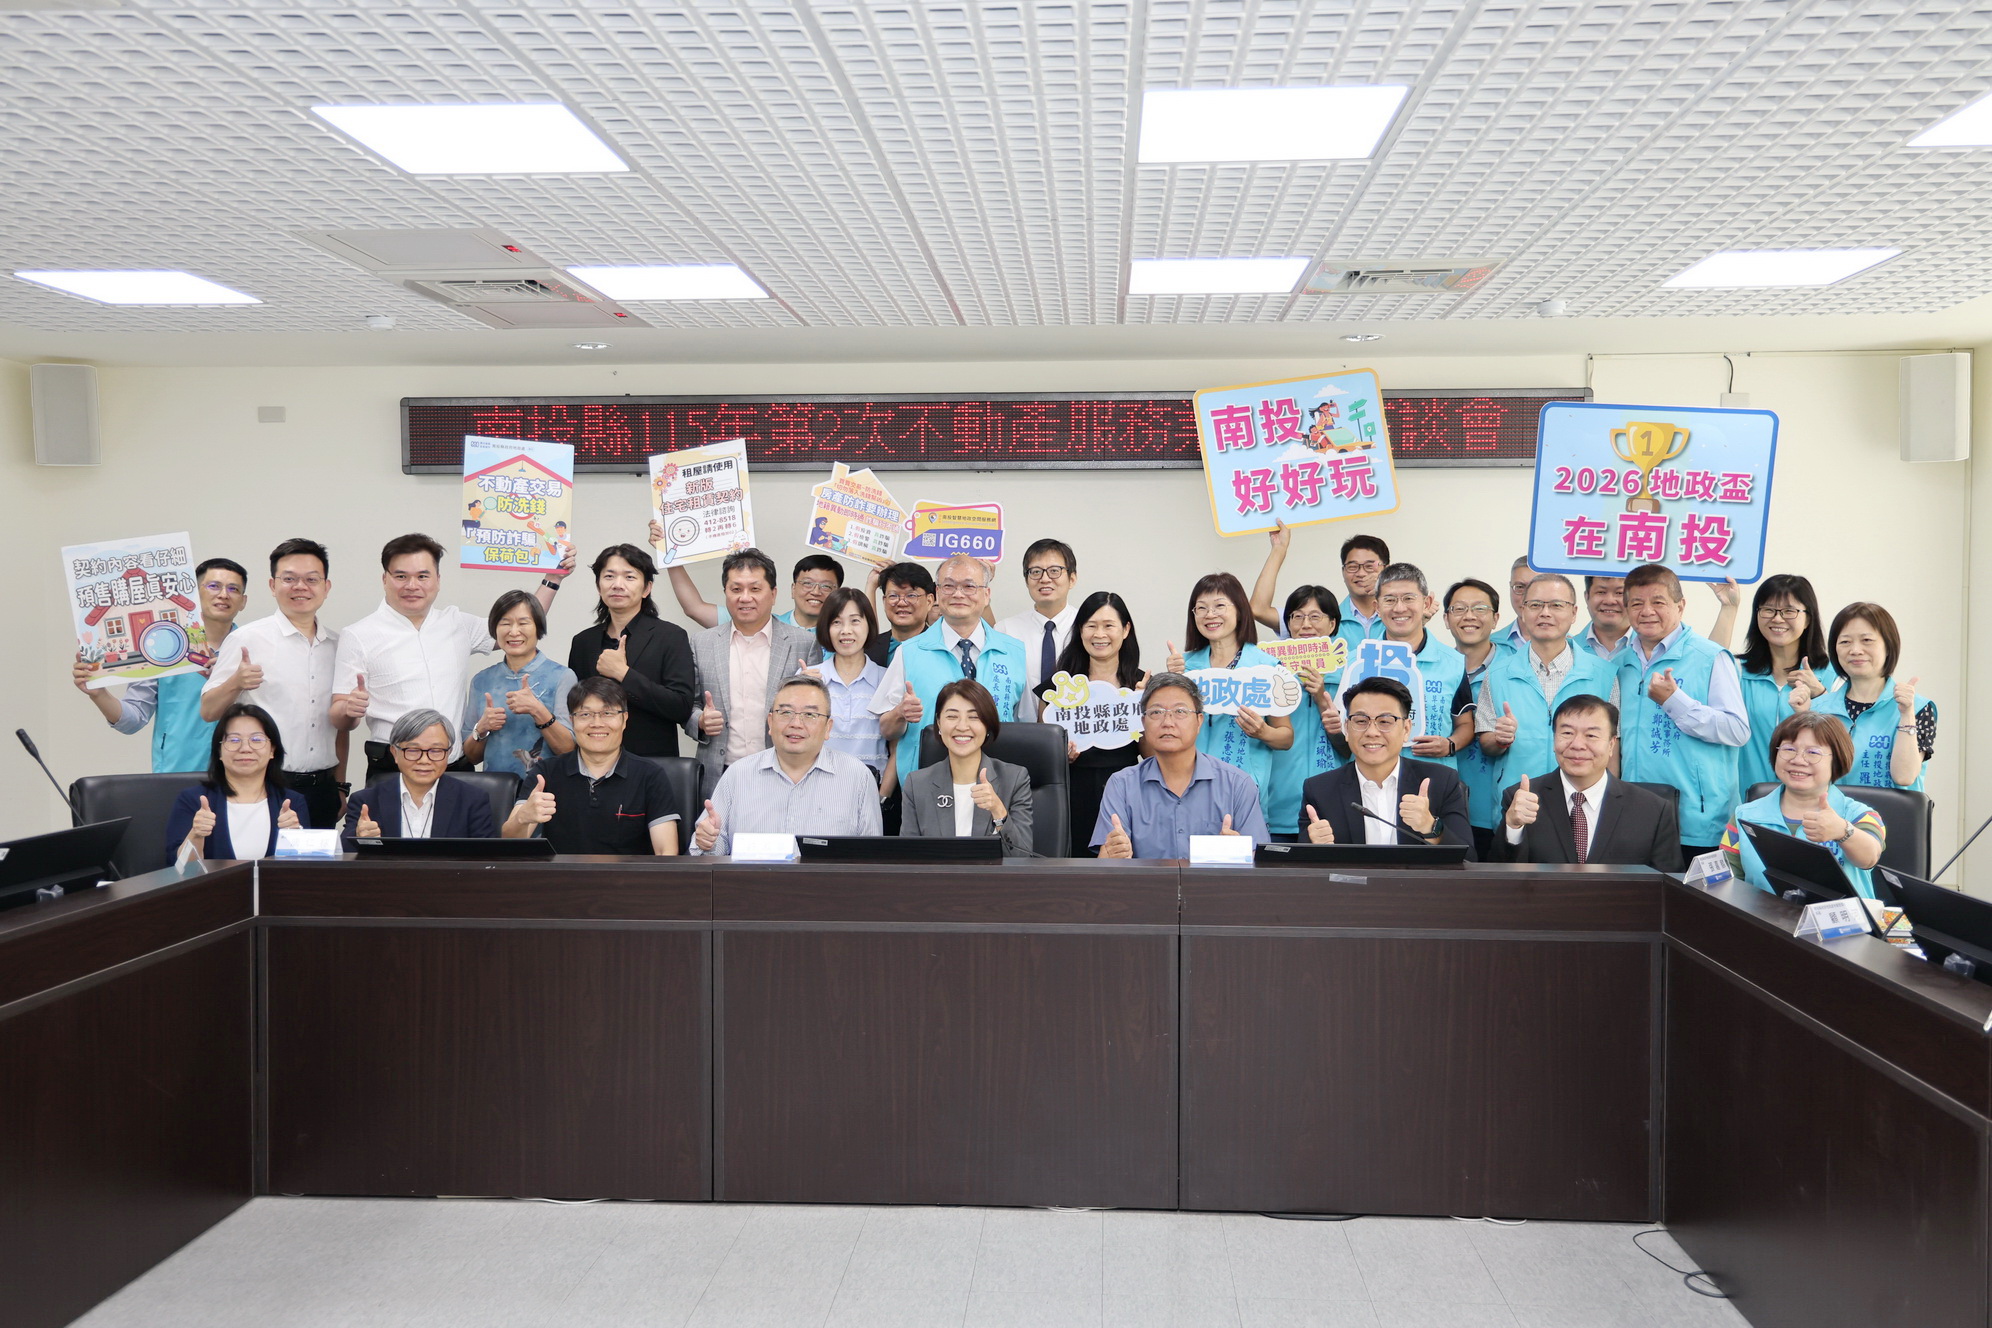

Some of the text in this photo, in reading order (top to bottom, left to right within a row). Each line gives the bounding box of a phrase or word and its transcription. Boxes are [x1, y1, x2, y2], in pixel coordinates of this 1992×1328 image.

[1209, 397, 1304, 453] 南投
[682, 459, 734, 479] 租屋請使用
[478, 474, 563, 498] 不動產交易
[685, 477, 714, 495] 新版
[1231, 455, 1377, 515] 好好玩
[497, 496, 547, 515] 防洗錢
[660, 488, 744, 516] 住宅租賃契約
[820, 486, 901, 523] 房產防詐要辦理
[704, 514, 736, 526] 412-8518
[939, 533, 995, 550] IG660
[1561, 510, 1733, 566] 在南投
[73, 546, 187, 579] 契約內容看仔細
[1262, 641, 1330, 660] 籍異動即時通
[1074, 717, 1129, 735] 地政處
